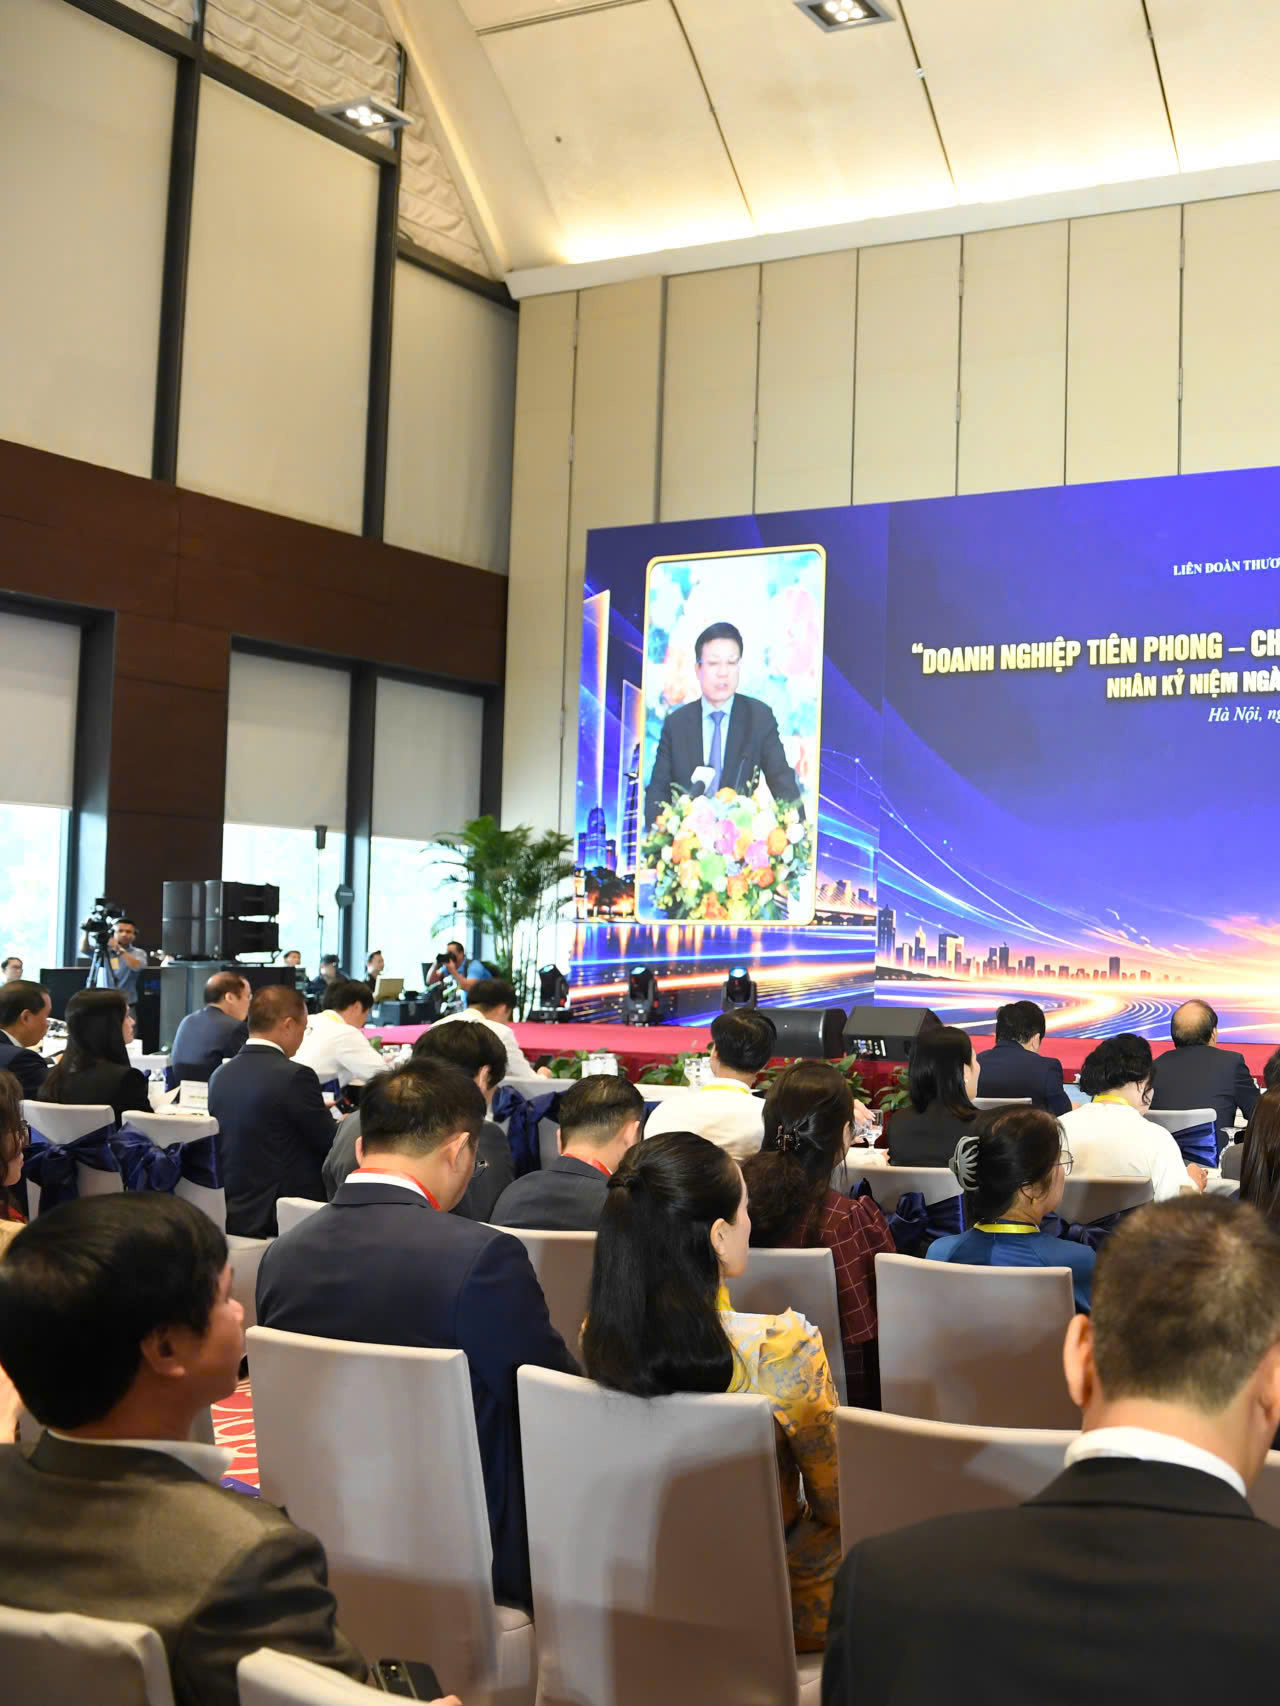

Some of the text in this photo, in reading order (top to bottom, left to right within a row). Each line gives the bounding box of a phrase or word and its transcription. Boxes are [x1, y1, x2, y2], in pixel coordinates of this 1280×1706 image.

[1173, 562, 1203, 576] LIÊN
[1205, 559, 1241, 574] ĐOÀN
[911, 642, 995, 674] “DOANH
[1000, 635, 1081, 673] NGHIỆP
[1087, 632, 1137, 666] TIÊN
[1143, 632, 1223, 663] PHONG
[1106, 672, 1157, 699] NHÂN
[1161, 667, 1186, 696] KỶ
[1189, 668, 1238, 698] NIỆM
[1208, 706, 1230, 723] Hà
[1233, 705, 1263, 724] Nội,
